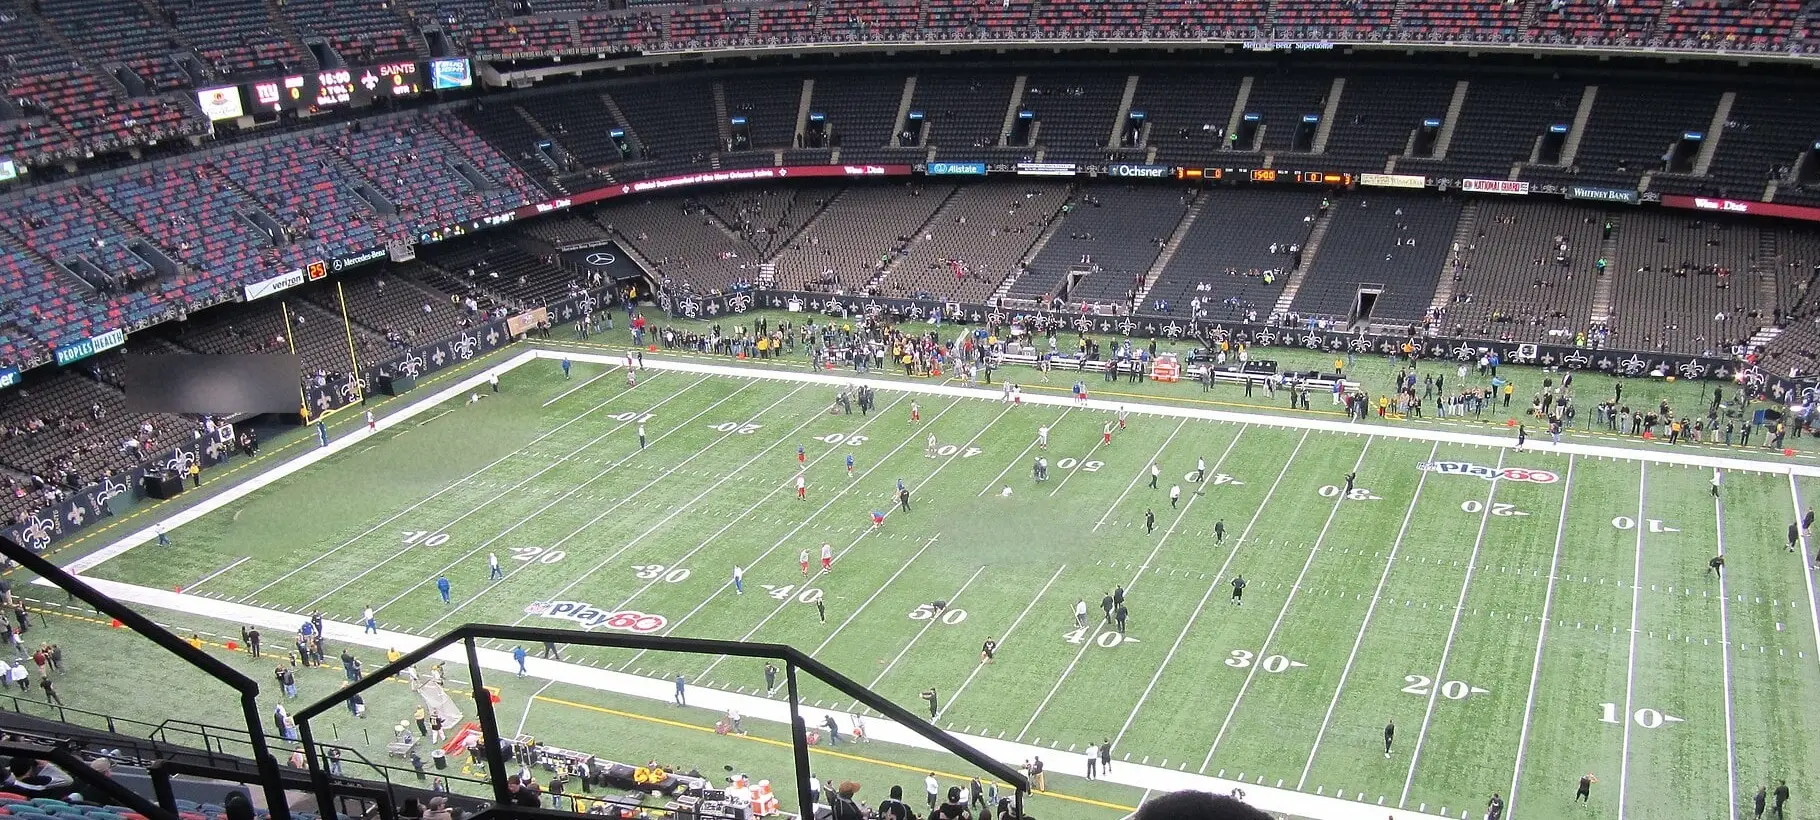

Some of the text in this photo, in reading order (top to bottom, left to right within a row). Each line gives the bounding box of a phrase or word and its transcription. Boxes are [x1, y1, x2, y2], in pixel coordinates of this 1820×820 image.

[380, 64, 415, 76] SAINTS
[948, 164, 977, 173] Allstate
[1119, 165, 1162, 177] Ochsner
[1473, 180, 1500, 191] NATIONAL
[1501, 182, 1520, 192] GUARD
[1573, 187, 1630, 200] WHITNEY BANK
[343, 249, 387, 268] Mercedes-Benz
[309, 264, 325, 280] 25
[272, 275, 302, 290] verizon
[58, 331, 123, 362] PEOPLES HEALTH
[717, 422, 762, 434] 20
[824, 433, 868, 445] 30
[938, 445, 982, 458] 40
[1056, 457, 1105, 472] 50
[1184, 471, 1233, 485] 40
[1461, 500, 1515, 516] 20
[1611, 516, 1664, 533] 10
[401, 530, 450, 547] 10
[510, 546, 567, 564] 20
[635, 564, 691, 583] 30
[767, 584, 823, 603] 40
[908, 603, 968, 625] 50
[1062, 626, 1123, 648] 40
[1224, 649, 1289, 673] 30
[1400, 674, 1469, 700] 20
[1597, 702, 1663, 729] 10
